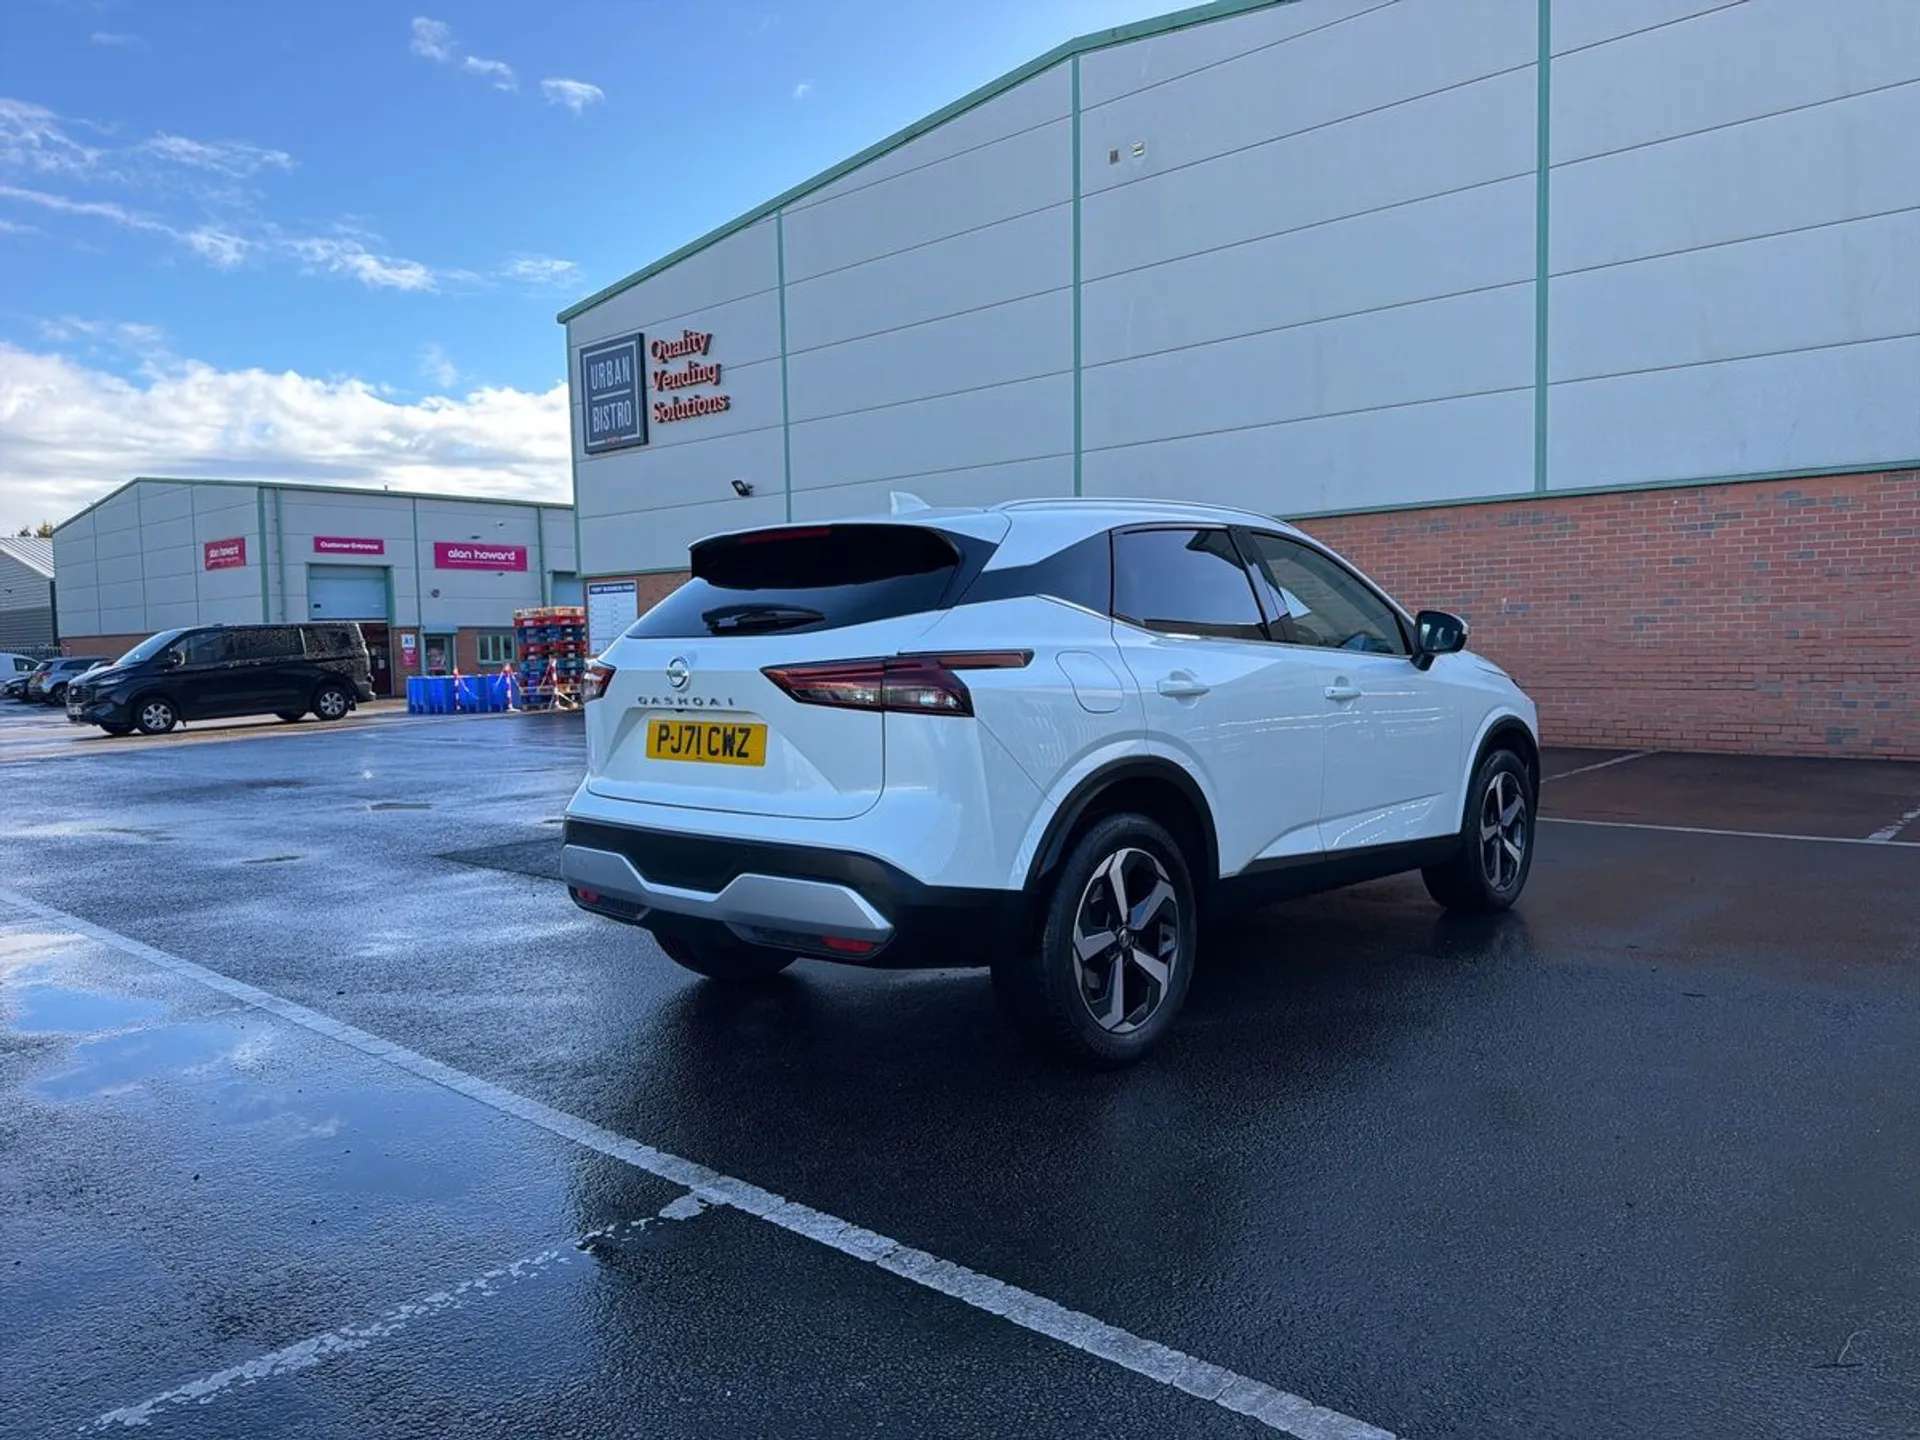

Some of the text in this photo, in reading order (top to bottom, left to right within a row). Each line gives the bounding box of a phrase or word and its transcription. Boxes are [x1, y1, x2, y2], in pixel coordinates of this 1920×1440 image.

[651, 330, 712, 363] Quality
[590, 355, 631, 390] URBAN
[652, 361, 721, 391] Vending
[592, 400, 632, 433] BISTRO
[654, 395, 730, 423] Solutions
[448, 548, 515, 561] alan howard
[637, 696, 735, 706] QASHQAI
[657, 723, 752, 758] PJ71 CWZ
